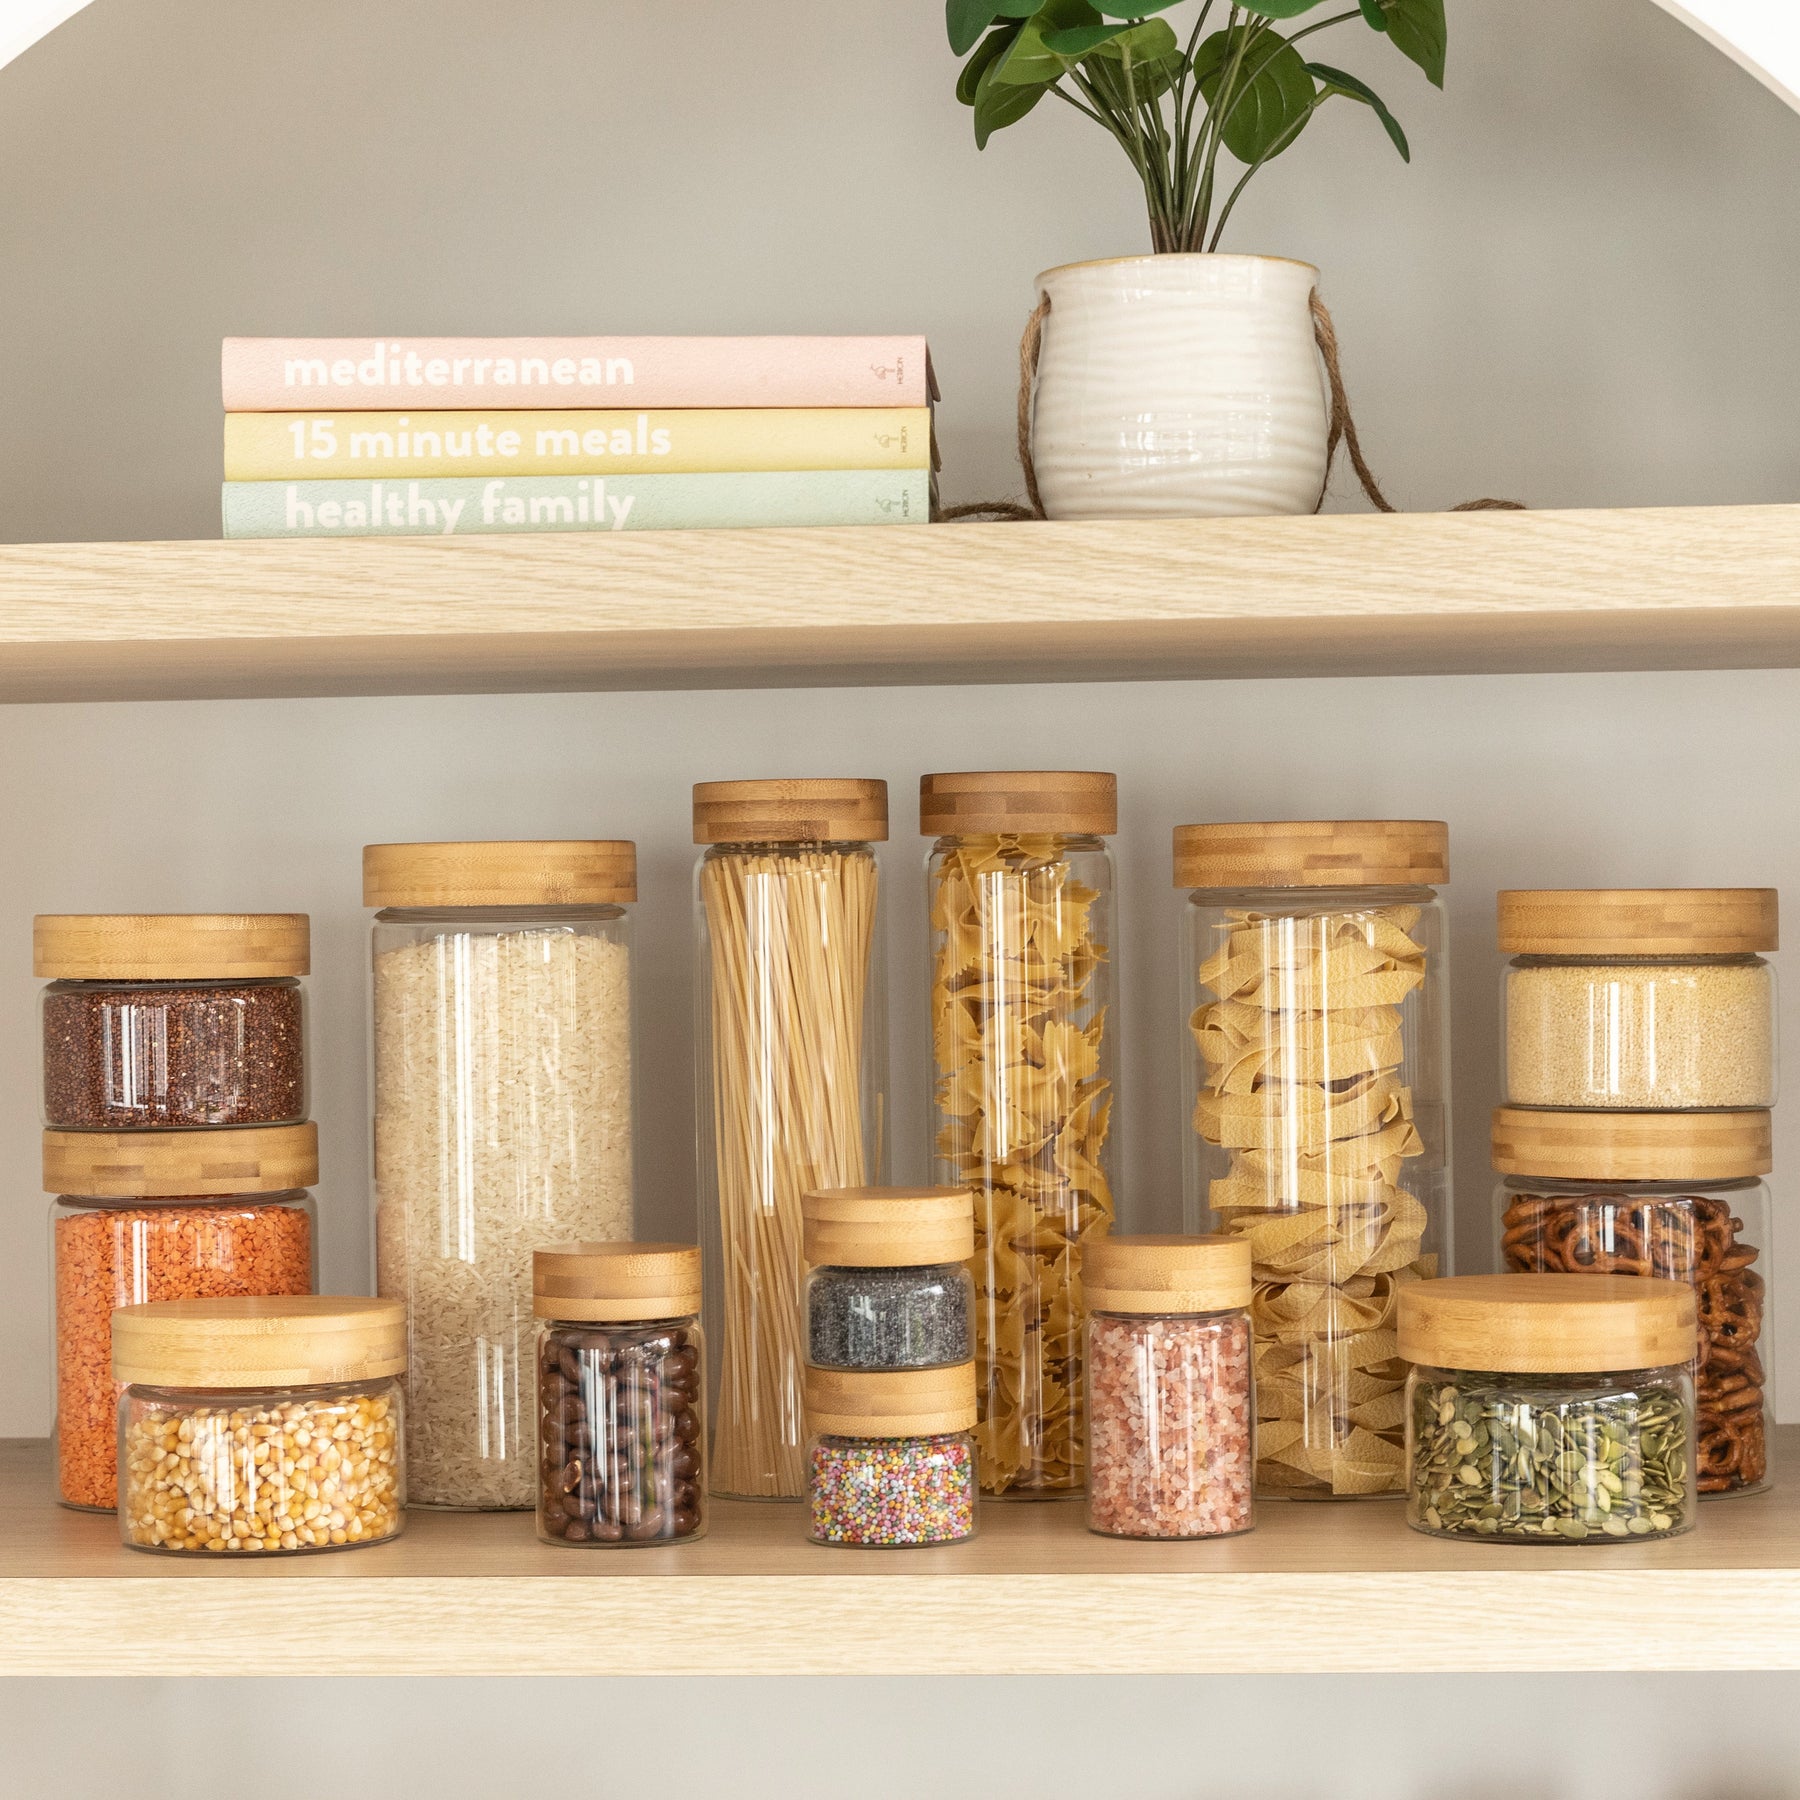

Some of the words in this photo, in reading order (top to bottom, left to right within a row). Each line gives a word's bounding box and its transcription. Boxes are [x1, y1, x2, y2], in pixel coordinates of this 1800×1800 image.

[285, 342, 635, 386] mediterranean
[287, 419, 338, 460] 15
[350, 418, 521, 458] minute
[535, 414, 672, 456] meals
[285, 484, 467, 535] healthy
[481, 478, 636, 531] family
